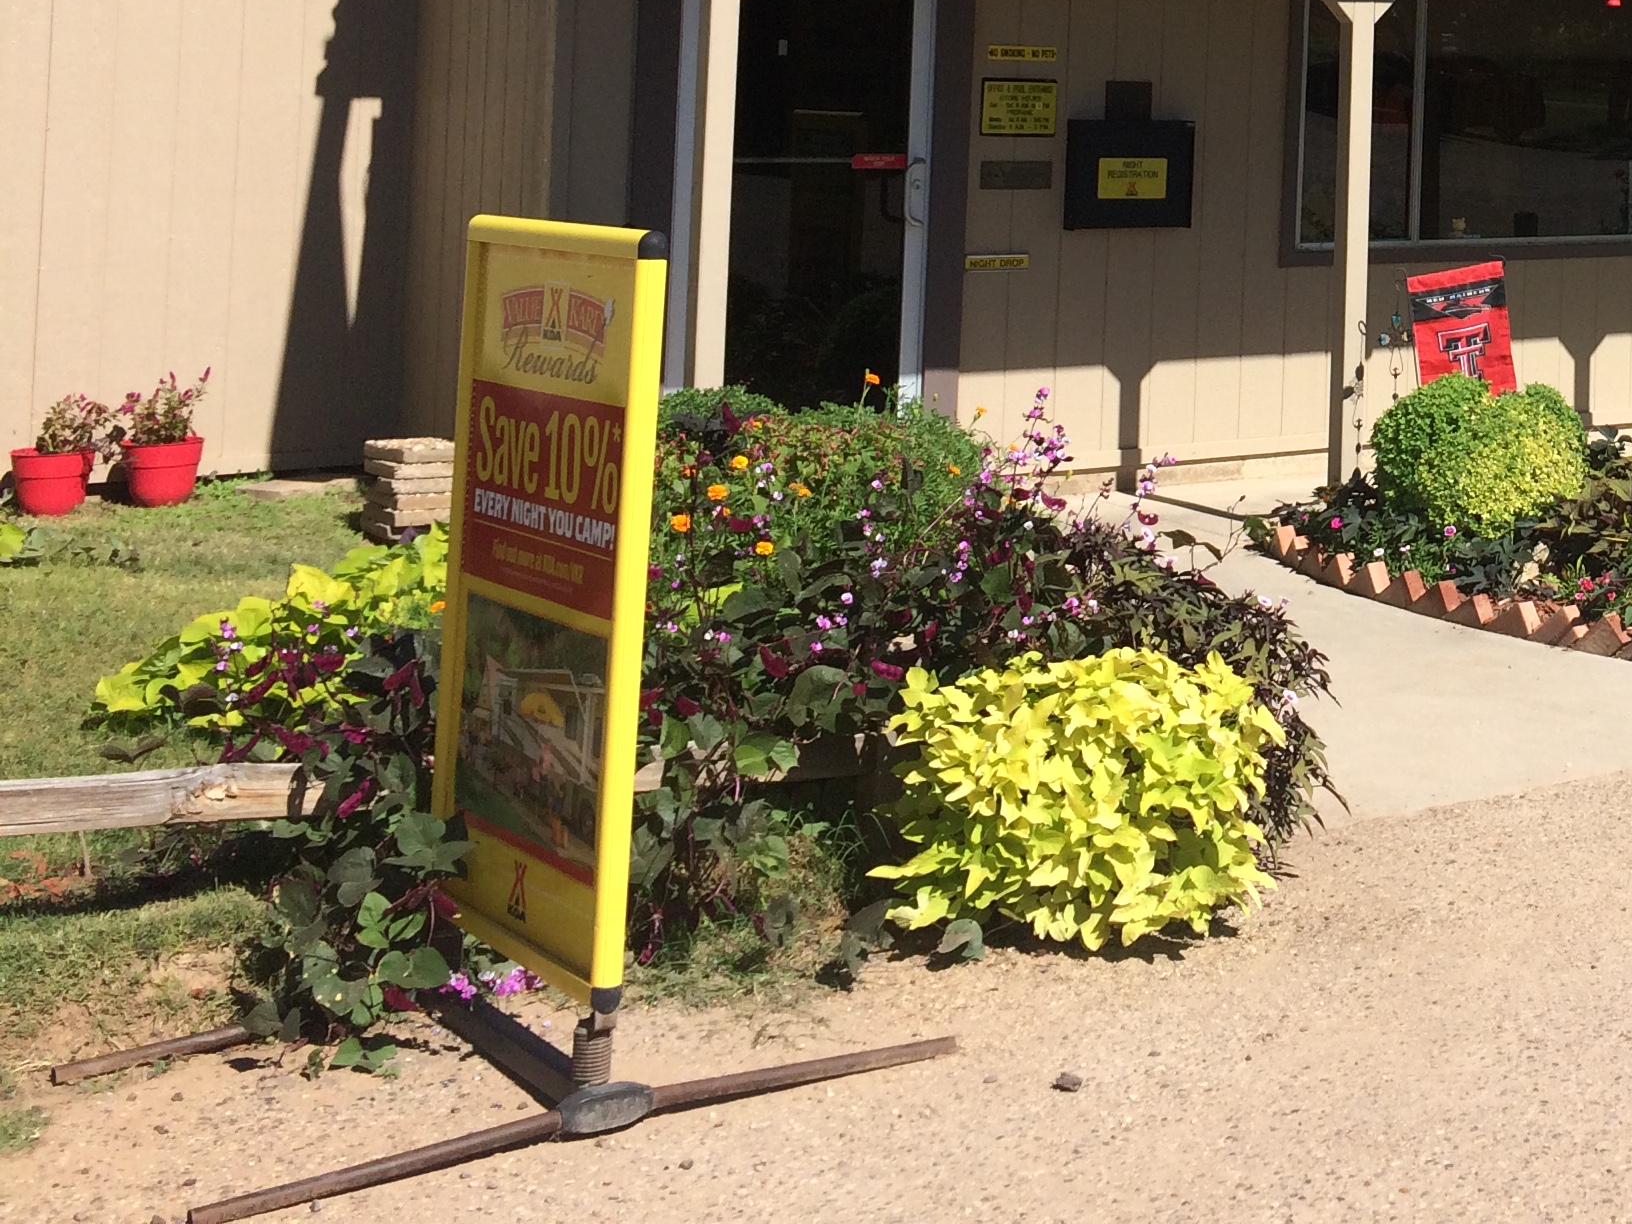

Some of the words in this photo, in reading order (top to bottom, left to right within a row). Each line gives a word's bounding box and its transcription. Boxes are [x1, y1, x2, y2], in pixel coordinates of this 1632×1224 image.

[1031, 49, 1040, 58] NO
[1122, 160, 1144, 169] NIGHT
[1107, 169, 1159, 179] REGISTRATION
[969, 259, 997, 268] NIGHT
[999, 258, 1025, 267] DROP
[504, 295, 543, 325] VALUE
[542, 328, 562, 342] KOA
[502, 326, 603, 384] Rewards
[475, 395, 540, 494] Save
[473, 488, 511, 521] EVERY
[510, 497, 547, 530] NIGHT
[548, 508, 574, 539] YOU
[574, 514, 616, 551] CAMP!
[506, 903, 527, 924] KOA
